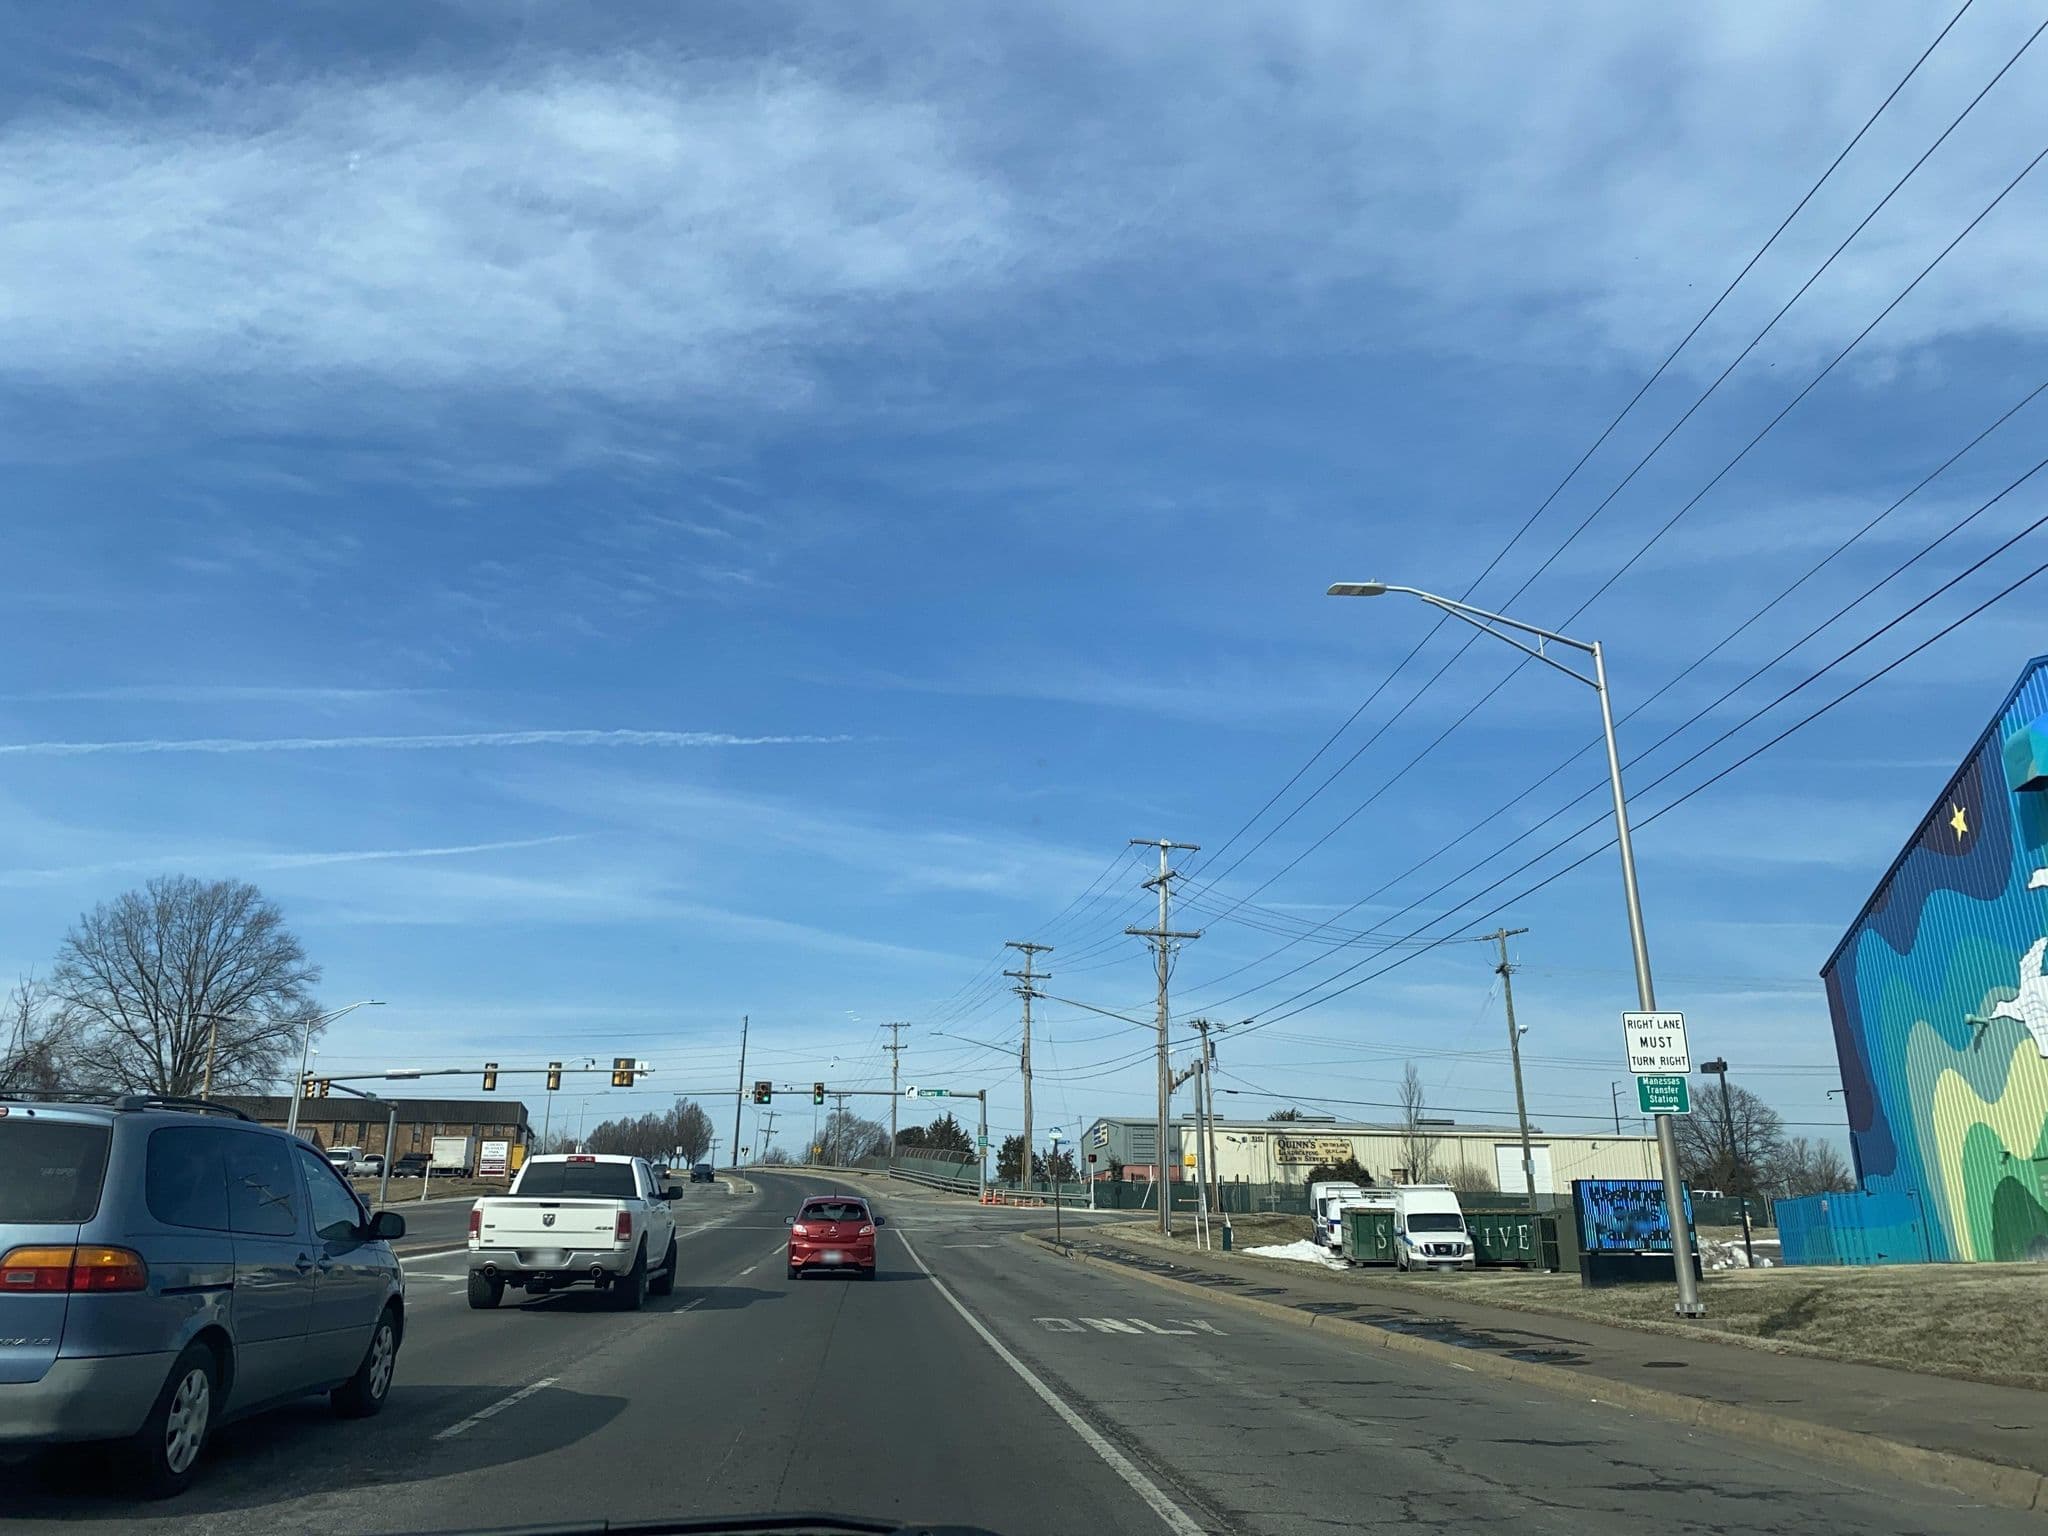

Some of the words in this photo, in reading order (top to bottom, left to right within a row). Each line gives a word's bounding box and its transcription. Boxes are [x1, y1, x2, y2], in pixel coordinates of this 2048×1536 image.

[1627, 1019, 1653, 1029] RIGHT
[1657, 1019, 1681, 1029] LANE
[1640, 1036, 1672, 1048] MUST
[1632, 1056, 1655, 1066] TURN
[1660, 1056, 1686, 1066] RIGHT
[1646, 1086, 1679, 1094] Transfer
[1650, 1095, 1679, 1103] Station
[1278, 1139, 1316, 1149] QUINN'S
[1033, 1317, 1231, 1336] ONLY
